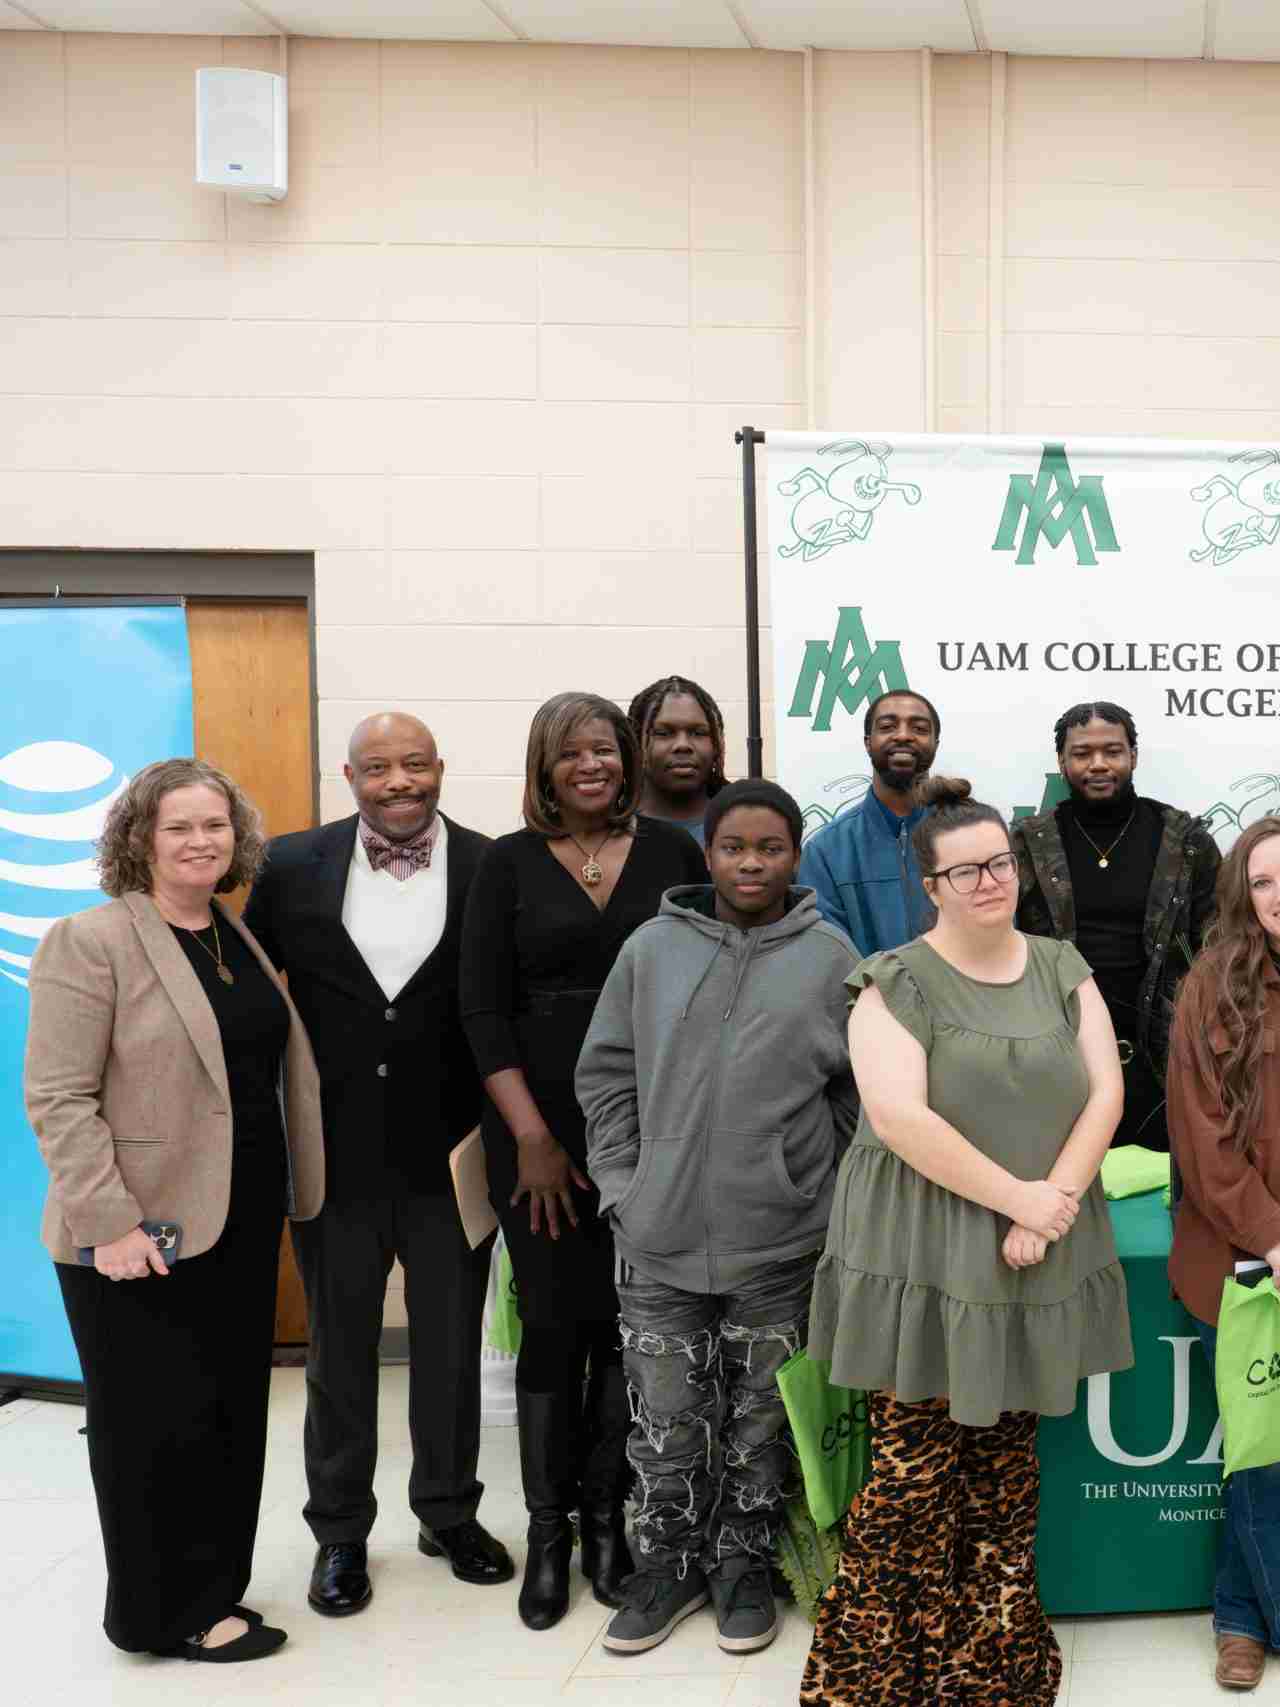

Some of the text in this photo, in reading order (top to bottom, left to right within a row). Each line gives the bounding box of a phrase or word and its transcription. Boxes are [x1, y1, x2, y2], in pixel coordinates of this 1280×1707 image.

[937, 641, 1029, 672] UAM
[1044, 641, 1223, 673] COLLEGE
[1080, 1482, 1118, 1499] THE
[1123, 1481, 1224, 1499] UNIVERSITY
[1159, 1507, 1228, 1522] MONTICE
